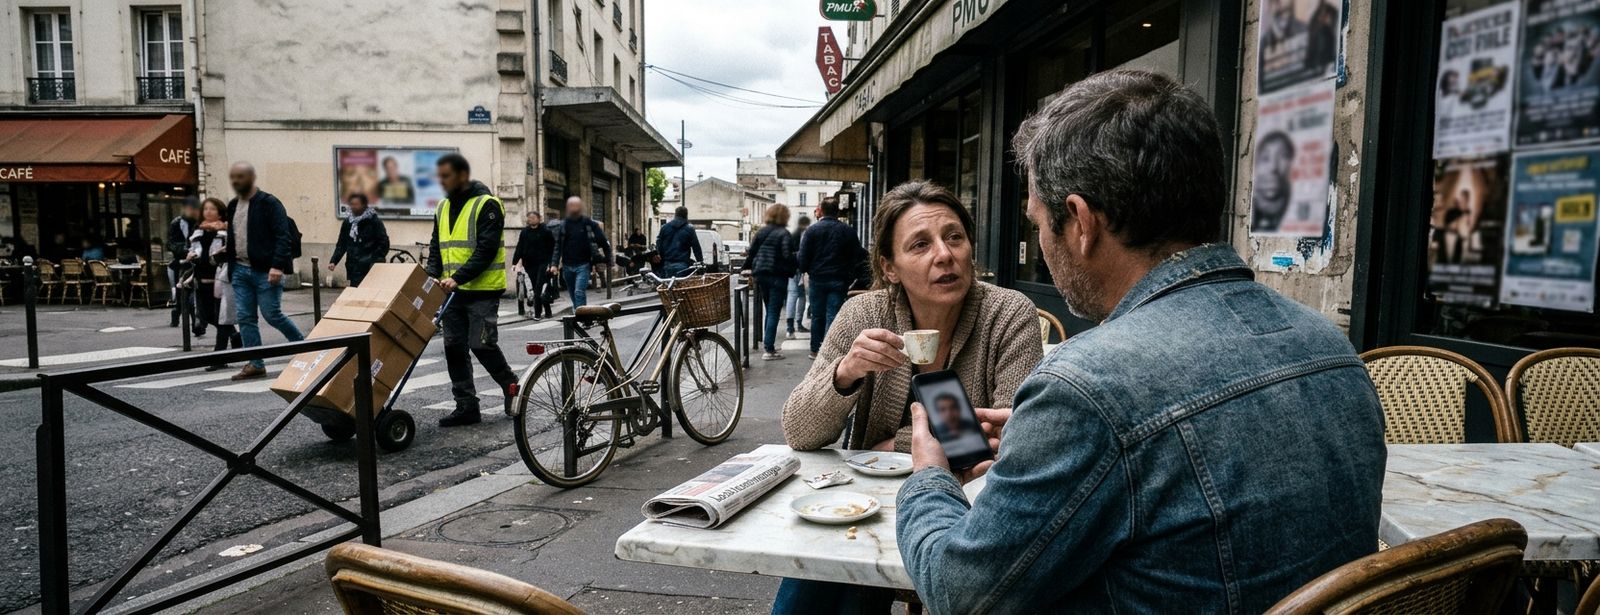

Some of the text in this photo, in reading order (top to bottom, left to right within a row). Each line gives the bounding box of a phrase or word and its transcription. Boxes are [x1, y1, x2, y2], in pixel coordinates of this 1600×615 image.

[826, 2, 853, 13] PMU
[821, 32, 840, 87] TABAC
[159, 148, 191, 164] CAFÉ
[0, 165, 34, 180] CAFÉ
